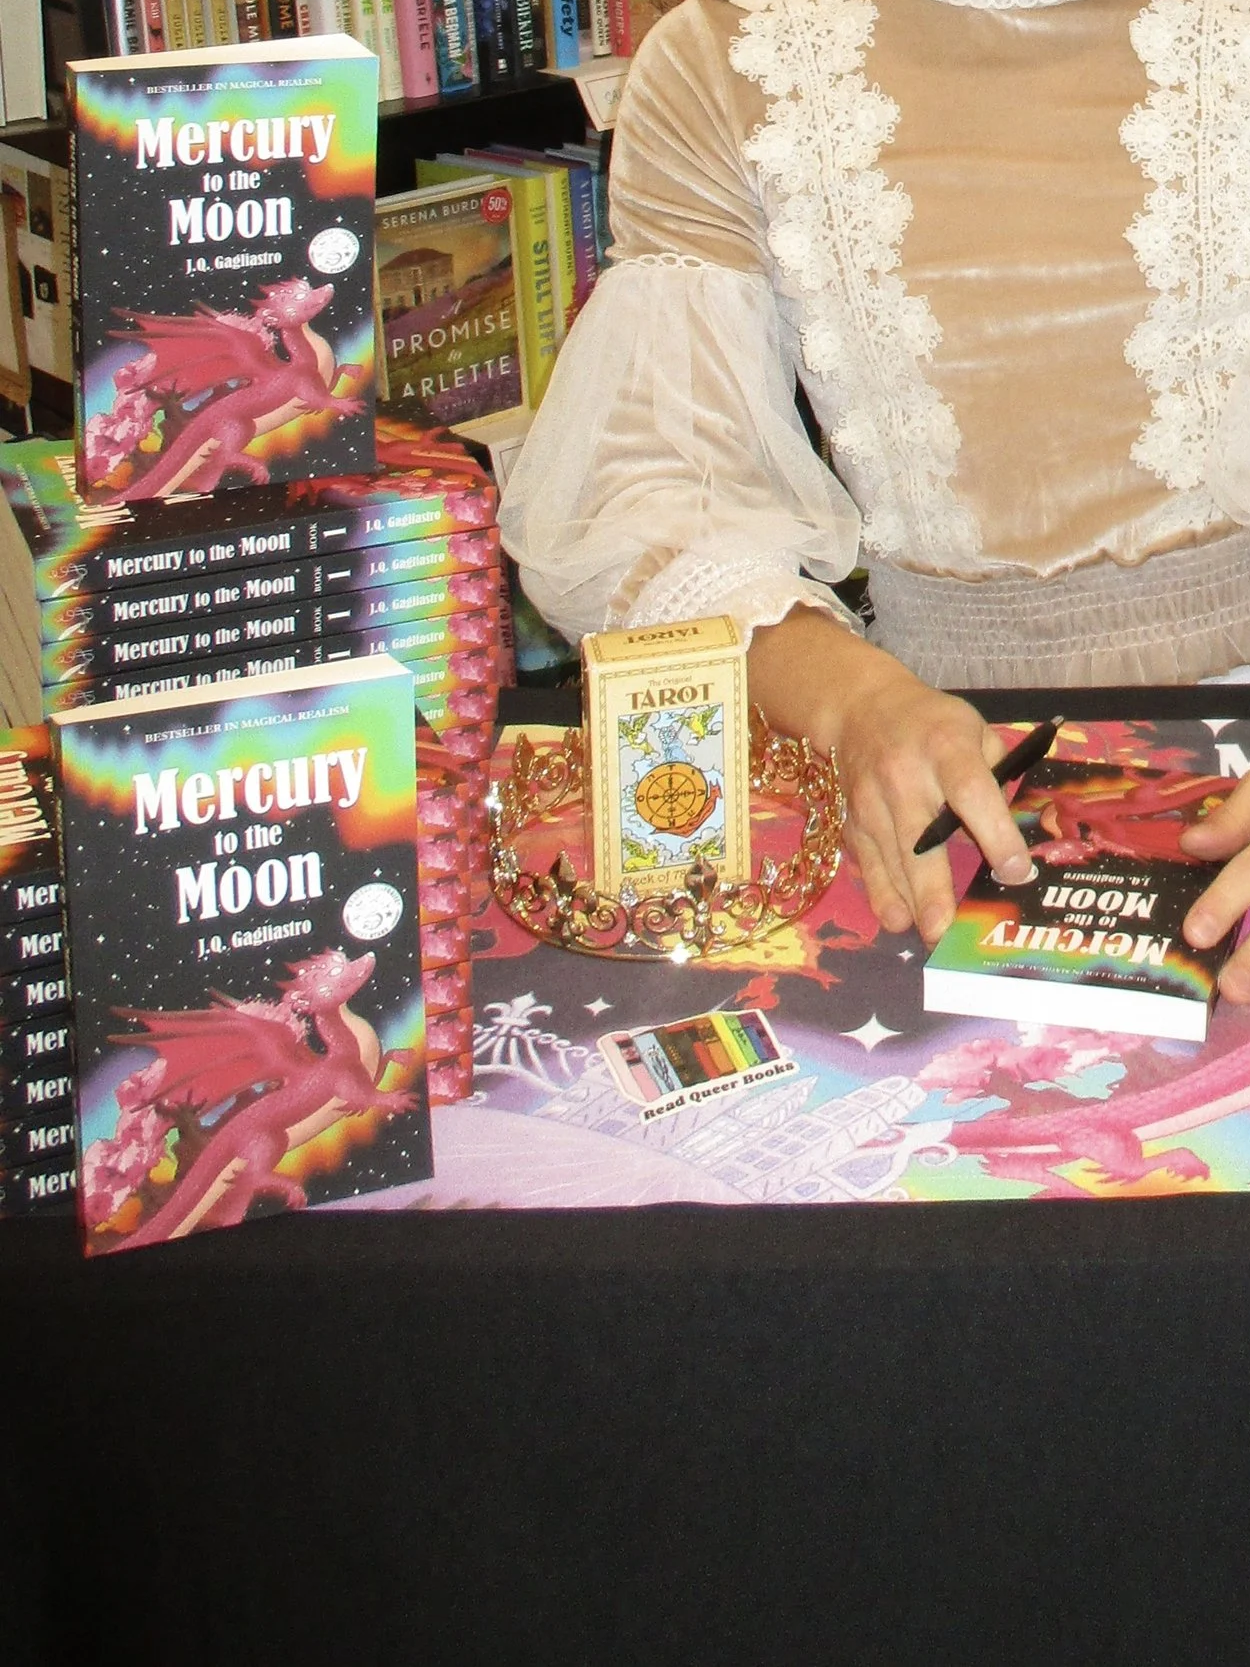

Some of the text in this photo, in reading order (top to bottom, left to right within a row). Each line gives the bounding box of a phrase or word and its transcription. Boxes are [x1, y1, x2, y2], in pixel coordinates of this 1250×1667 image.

[443, 8, 463, 59] BERMAN
[135, 114, 336, 170] Mercury
[203, 169, 261, 193] to the
[168, 196, 293, 246] Moon
[381, 206, 438, 230] SERENA
[213, 250, 283, 272] Gagliastro
[532, 240, 554, 304] STILL
[391, 309, 513, 359] PROMISE
[401, 354, 513, 399] ARLETTE
[106, 531, 291, 579] Mercury Moon
[625, 682, 716, 711] TAROT
[662, 674, 693, 685] Original
[144, 704, 350, 743] BESTSELLER IN MAGICAL REALISM
[131, 746, 368, 836] Mercury
[214, 823, 283, 856] to the
[176, 851, 324, 926] Moon
[643, 1061, 796, 1122] Read Queer Books
